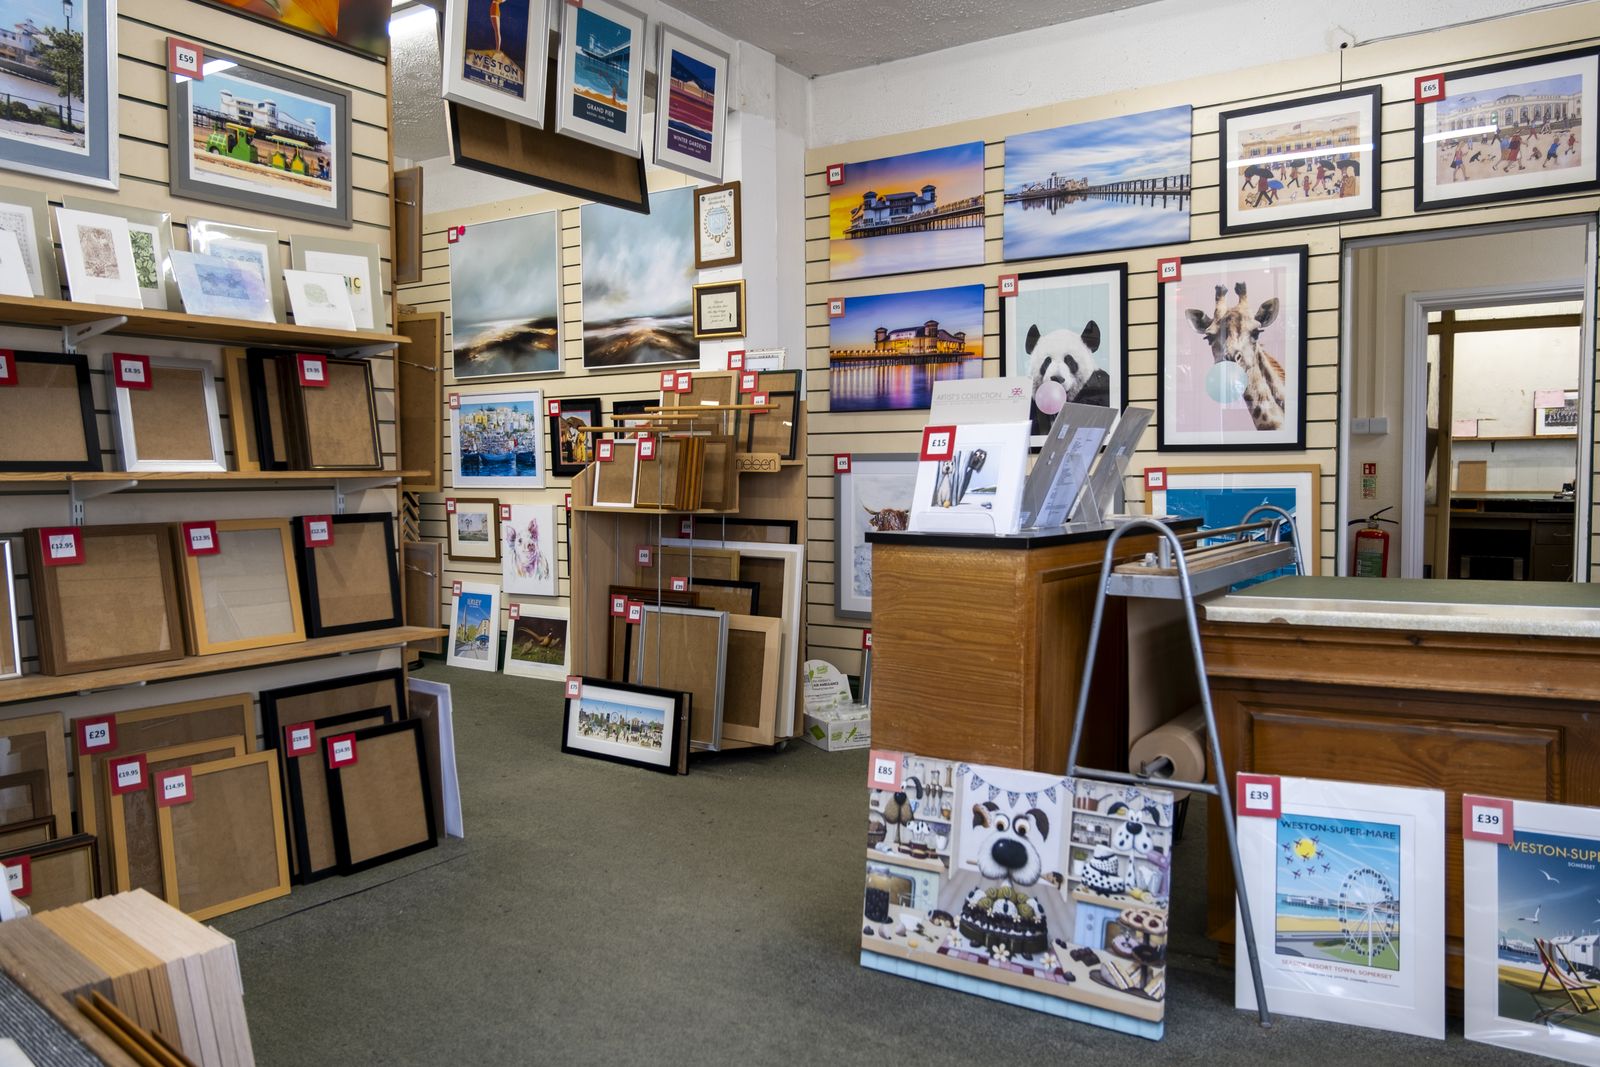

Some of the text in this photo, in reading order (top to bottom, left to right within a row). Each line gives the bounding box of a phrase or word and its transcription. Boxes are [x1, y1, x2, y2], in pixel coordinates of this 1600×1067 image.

[178, 53, 194, 64] £59
[473, 52, 518, 77] WESTON
[1423, 85, 1438, 93] £65
[586, 103, 615, 118] GRAND PIER
[673, 134, 688, 145] WINTER
[688, 140, 707, 151] GARDENS
[961, 391, 1002, 400] COLLECTION
[932, 440, 946, 449] £15
[192, 534, 211, 542] £12.95
[52, 539, 74, 550] £12.95
[89, 730, 106, 740] £29
[118, 770, 139, 779] £19.95
[878, 766, 893, 777] £85
[165, 782, 185, 791] £14.95
[1250, 790, 1270, 802] £39
[1477, 814, 1500, 826] £39
[1280, 820, 1396, 840] WESTON-SUPER-MARE
[1567, 861, 1595, 870] SOMERSET
[1307, 962, 1333, 971] RESORT
[1358, 969, 1393, 980] SOMERSET
